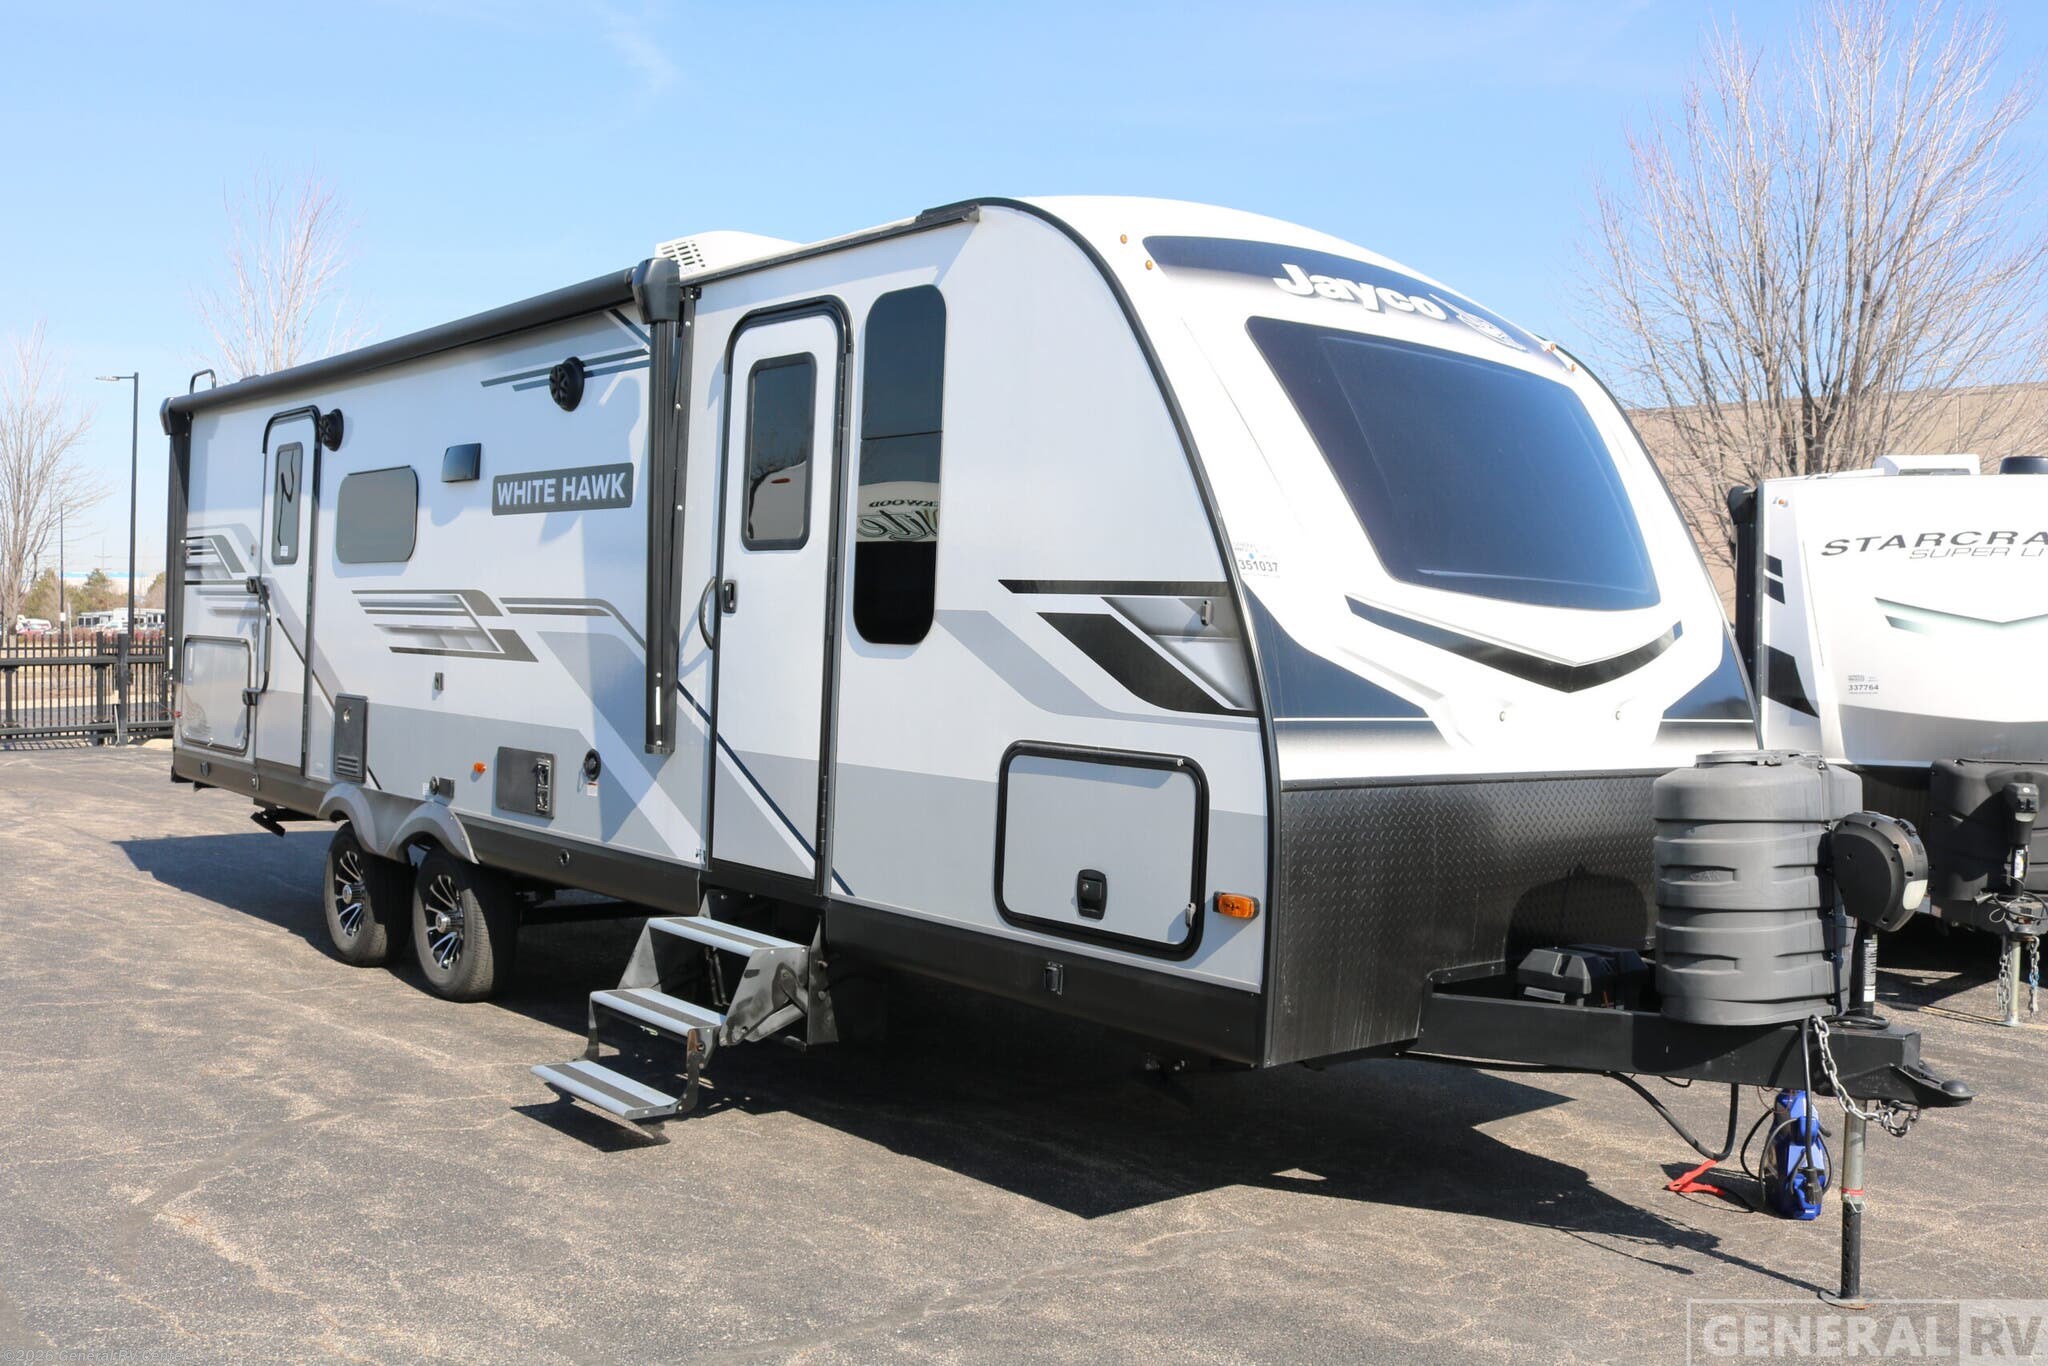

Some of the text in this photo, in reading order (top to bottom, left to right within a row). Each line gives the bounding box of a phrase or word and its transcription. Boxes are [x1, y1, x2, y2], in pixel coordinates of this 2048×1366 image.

[1272, 263, 1448, 321] Jayco
[497, 472, 626, 506] WHITE HAWK
[1821, 531, 2048, 557] STARCRA
[1908, 547, 2011, 559] SUPER
[1238, 559, 1278, 572] 351037
